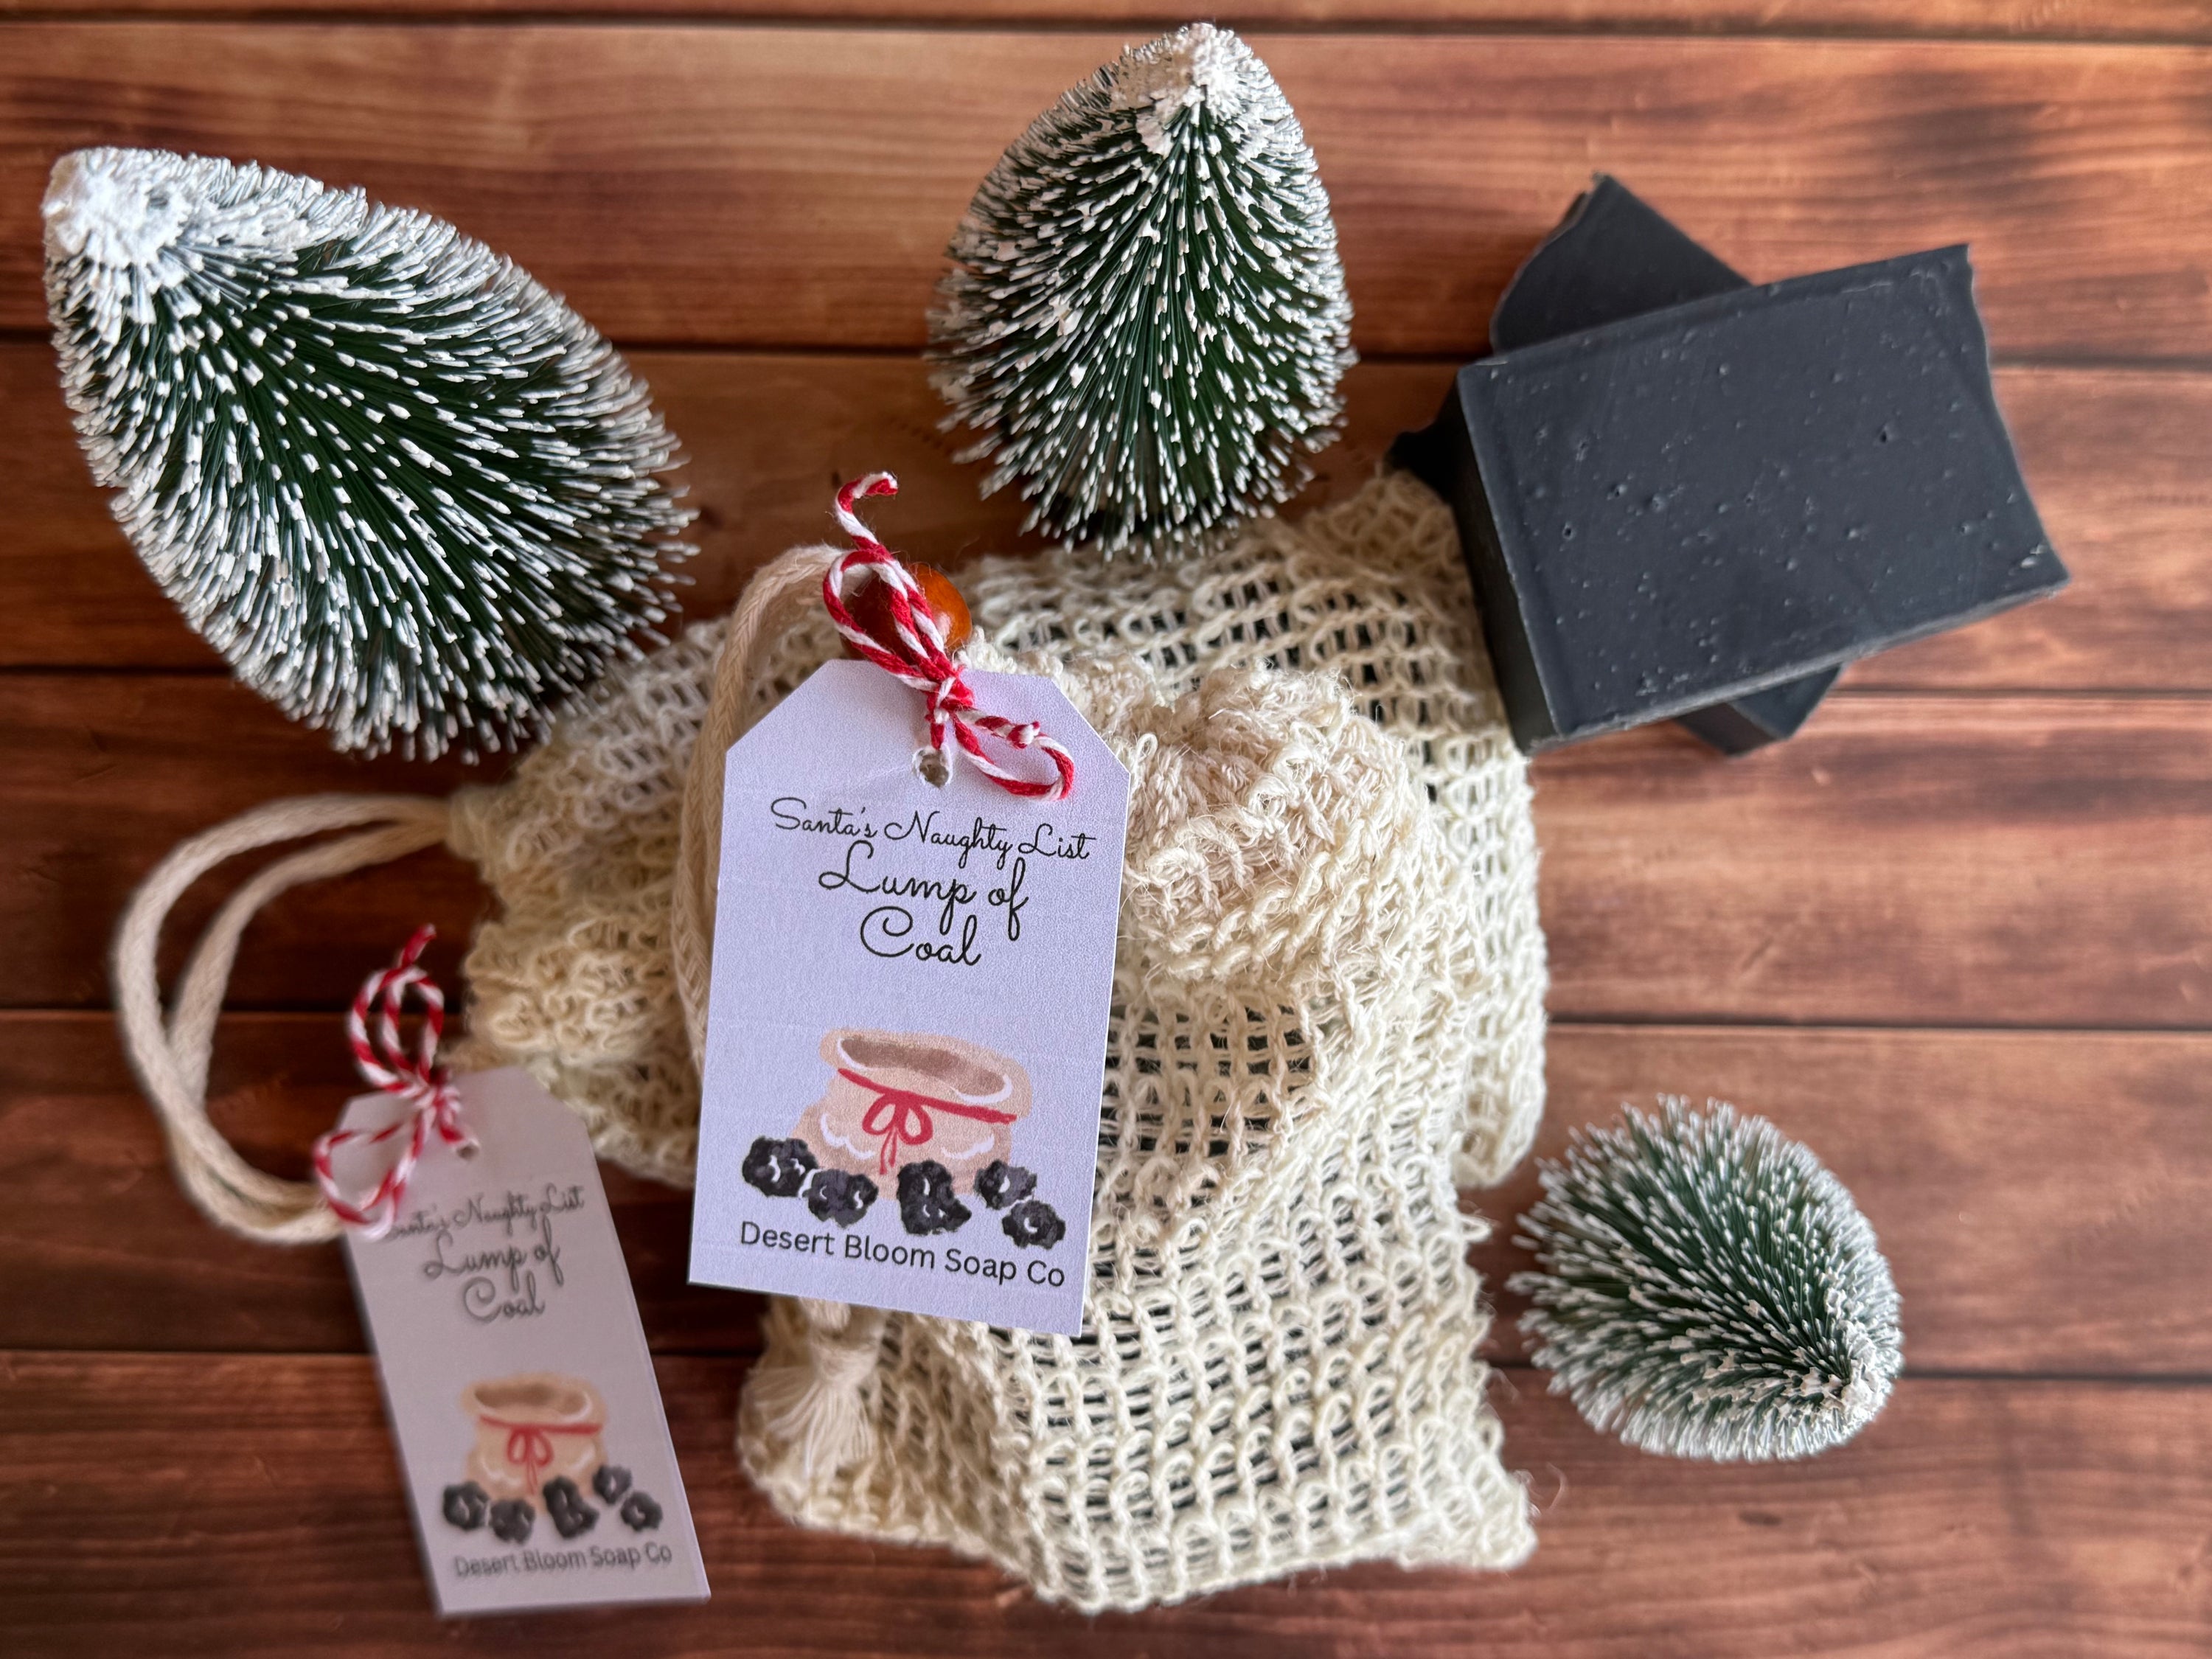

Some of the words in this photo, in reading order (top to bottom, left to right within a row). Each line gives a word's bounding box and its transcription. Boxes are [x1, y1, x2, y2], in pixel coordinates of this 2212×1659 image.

[771, 797, 877, 838] Santa's
[885, 811, 1013, 869] Naughty
[1018, 823, 1096, 860] List
[818, 840, 977, 935] Lump
[988, 857, 1029, 941] of
[860, 905, 981, 966] Coal
[453, 1190, 539, 1236] Naughty
[536, 1183, 585, 1213] List
[424, 1231, 528, 1295] Lump
[533, 1215, 563, 1286] of
[740, 1220, 835, 1256] Desert
[844, 1234, 935, 1270] Bloom
[945, 1249, 1017, 1284] Soap
[1027, 1259, 1066, 1287] Co
[462, 1271, 546, 1323] Coal
[453, 1554, 518, 1579] Desert
[523, 1549, 586, 1571] Bloom
[591, 1546, 640, 1568] Soap
[644, 1541, 672, 1563] Co
